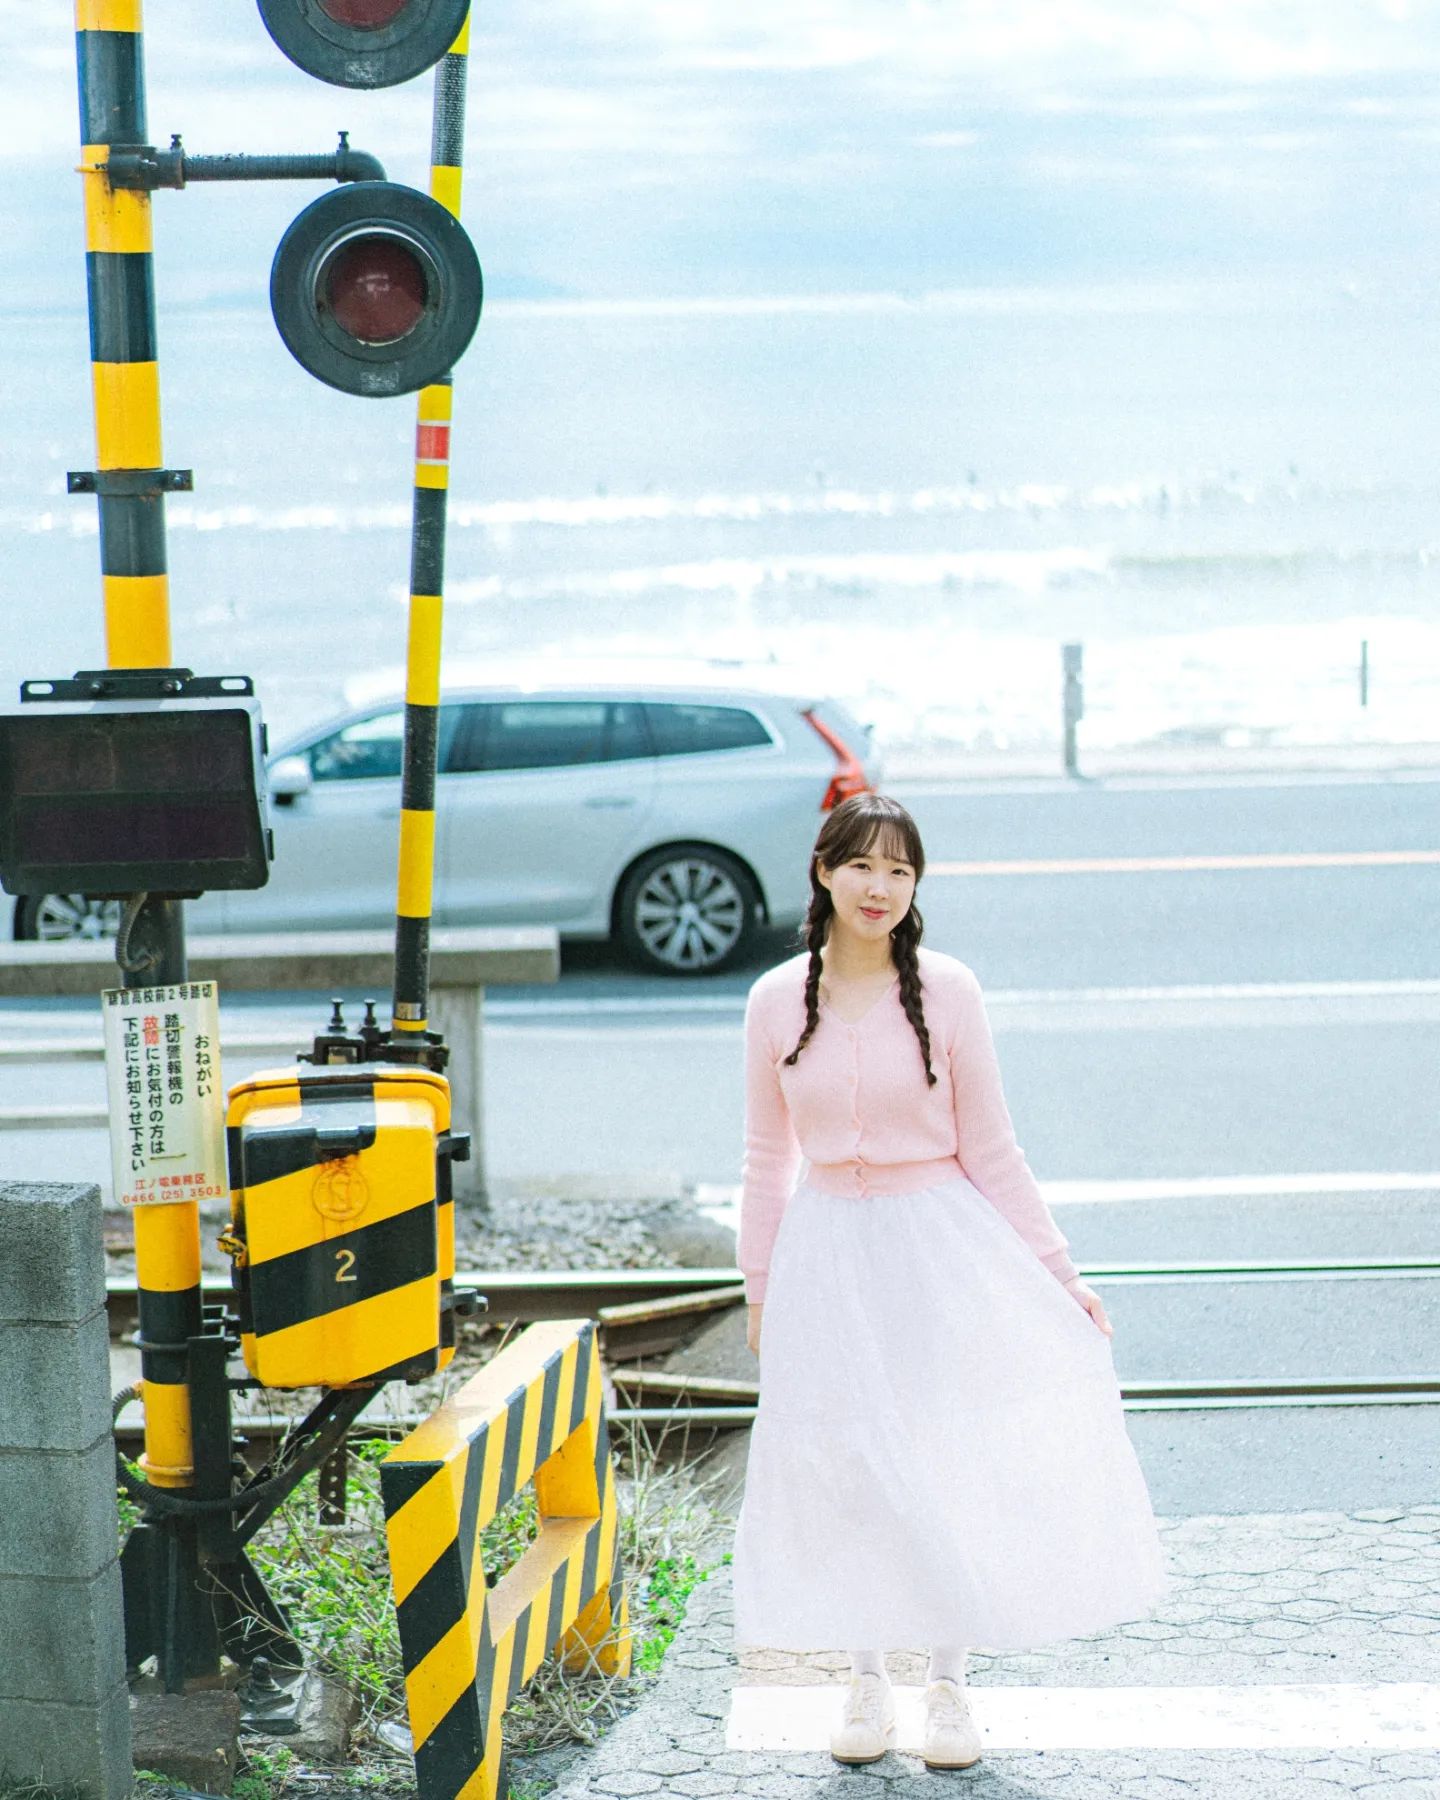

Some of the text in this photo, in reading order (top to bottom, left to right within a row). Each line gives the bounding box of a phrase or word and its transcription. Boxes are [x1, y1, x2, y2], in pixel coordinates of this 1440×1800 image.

[122, 1017, 145, 1171] 下記にお知らせ下さい
[143, 1016, 166, 1154] 故障にお気付の方は
[164, 1014, 183, 1105] 踏切警報機の
[194, 1035, 213, 1097] おねがい
[122, 1186, 221, 1204] 0466 (25) 3503
[334, 1249, 357, 1282] 2
